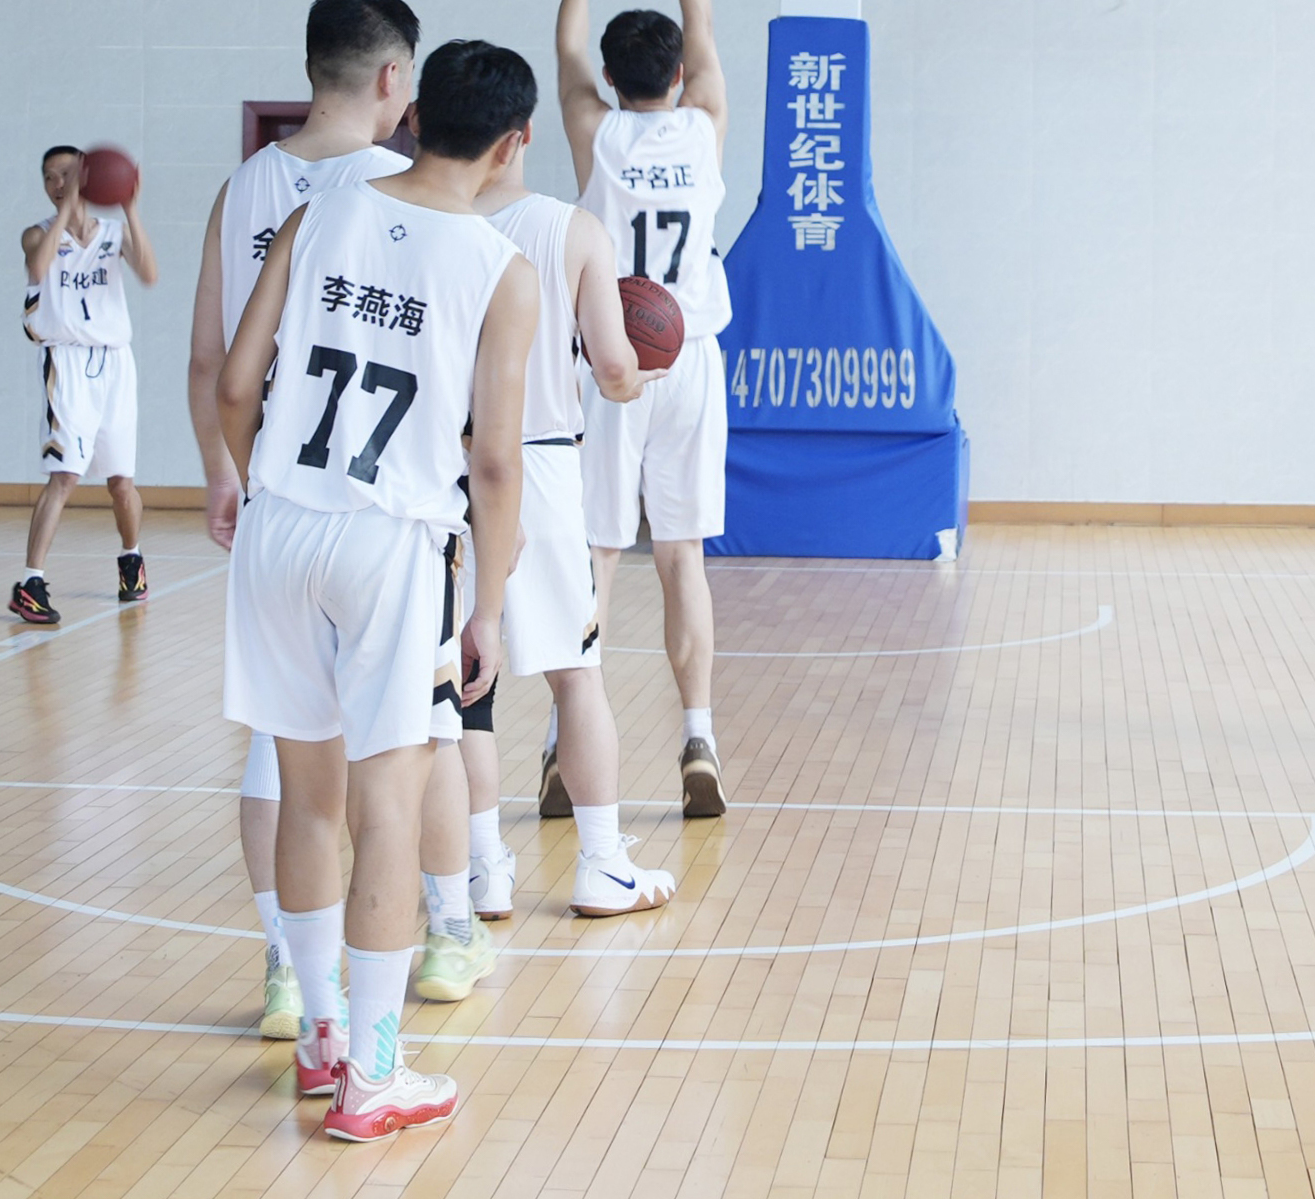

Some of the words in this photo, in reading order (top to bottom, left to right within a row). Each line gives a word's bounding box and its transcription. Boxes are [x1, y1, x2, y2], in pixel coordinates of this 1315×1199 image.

[620, 163, 695, 190] 宁名正
[786, 51, 847, 251] 新世纪体育
[630, 209, 691, 284] 17
[320, 275, 427, 336] 李燕海
[296, 344, 418, 485] 77
